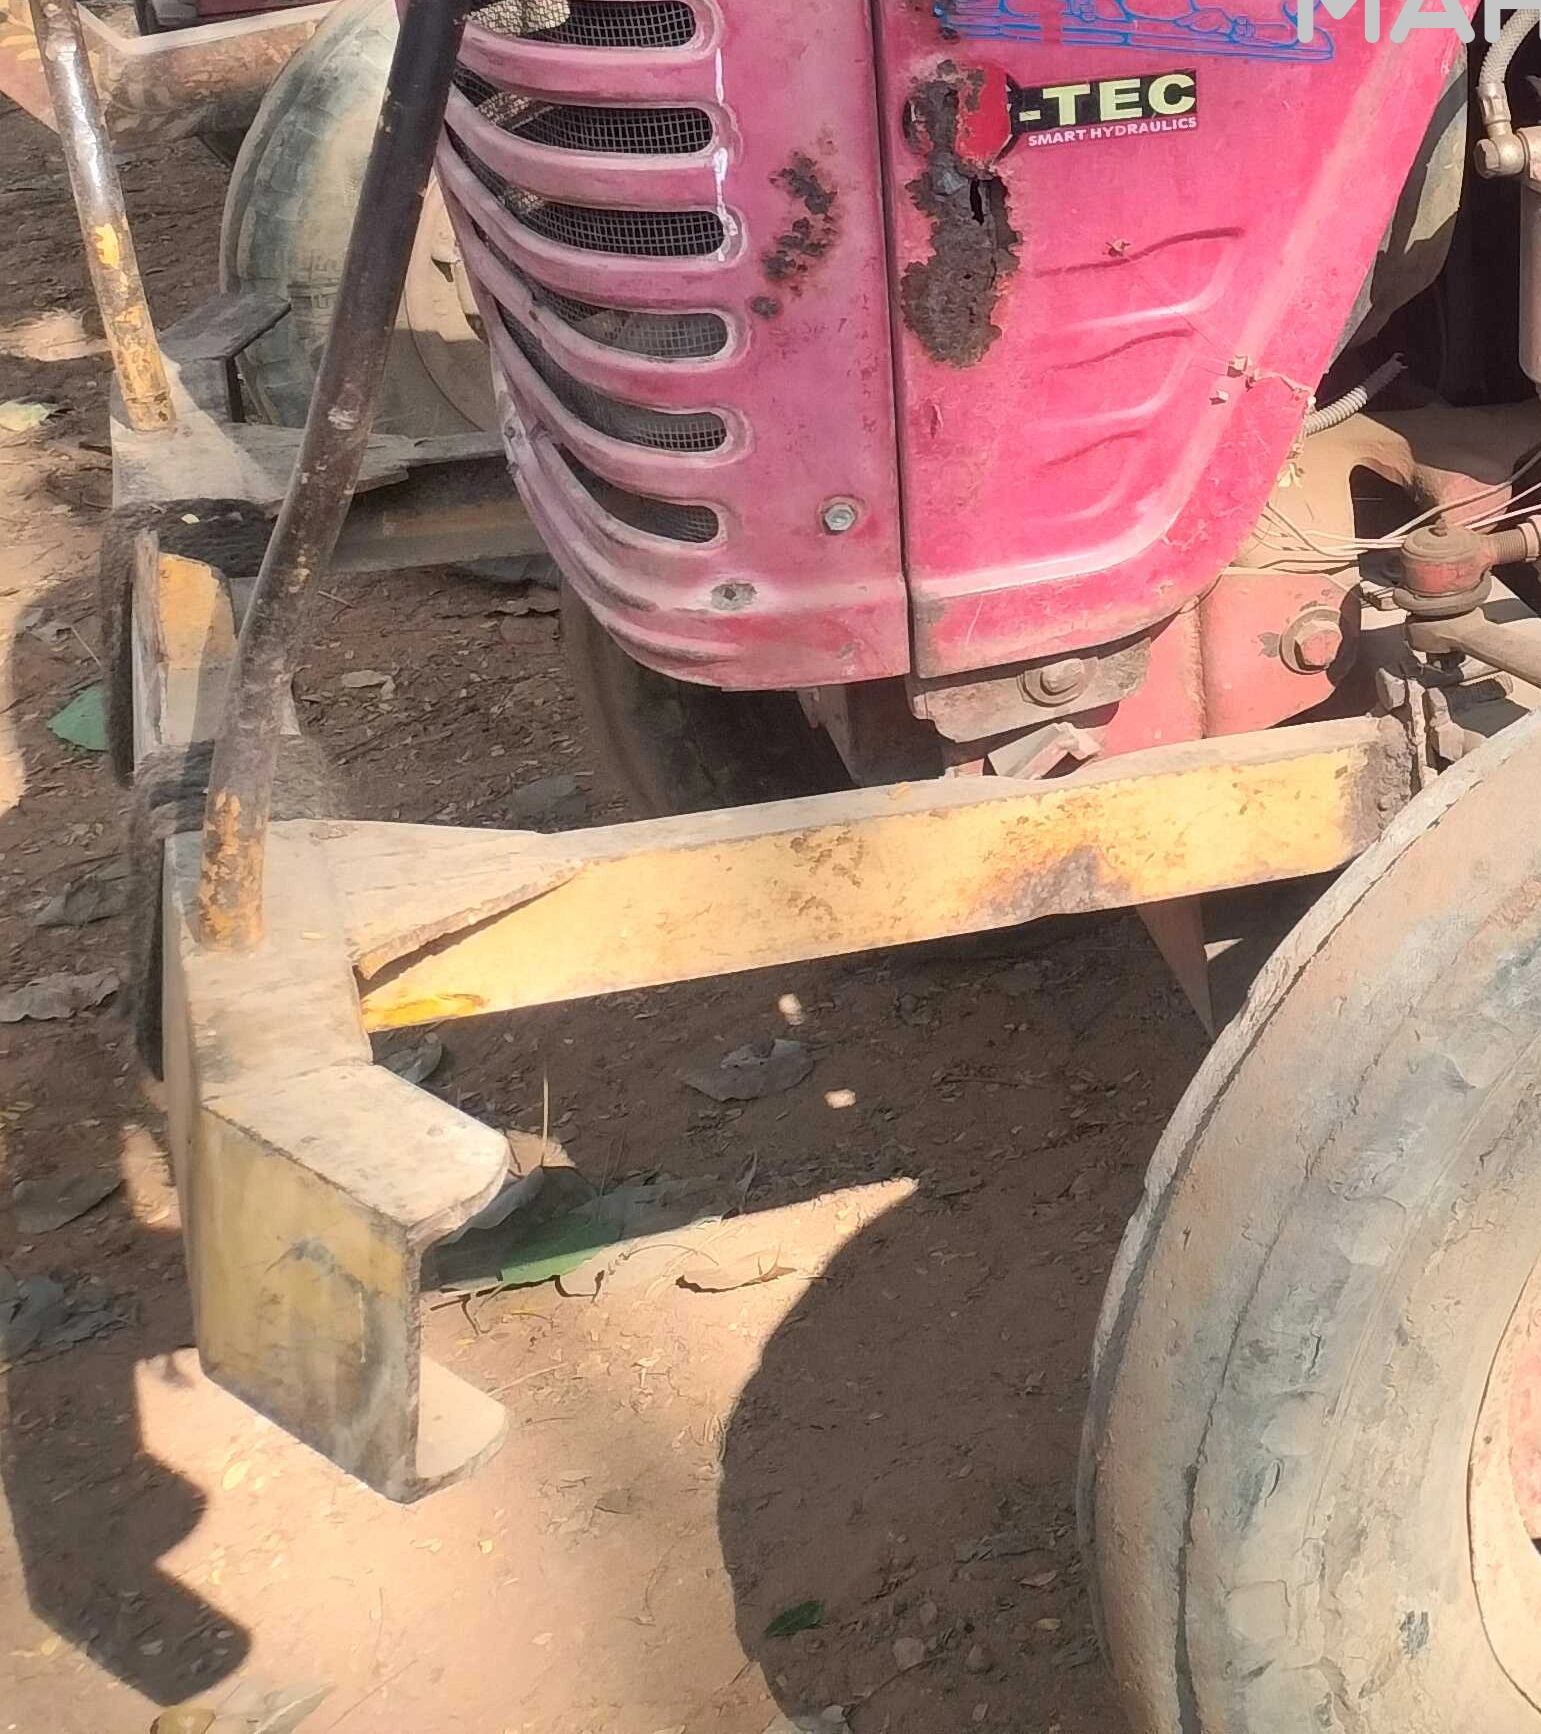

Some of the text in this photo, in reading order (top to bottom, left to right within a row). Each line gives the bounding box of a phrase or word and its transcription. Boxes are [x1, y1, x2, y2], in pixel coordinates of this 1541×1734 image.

[1005, 73, 1196, 127] -TEC
[1027, 116, 1197, 147] SMART HYDRAULICS
